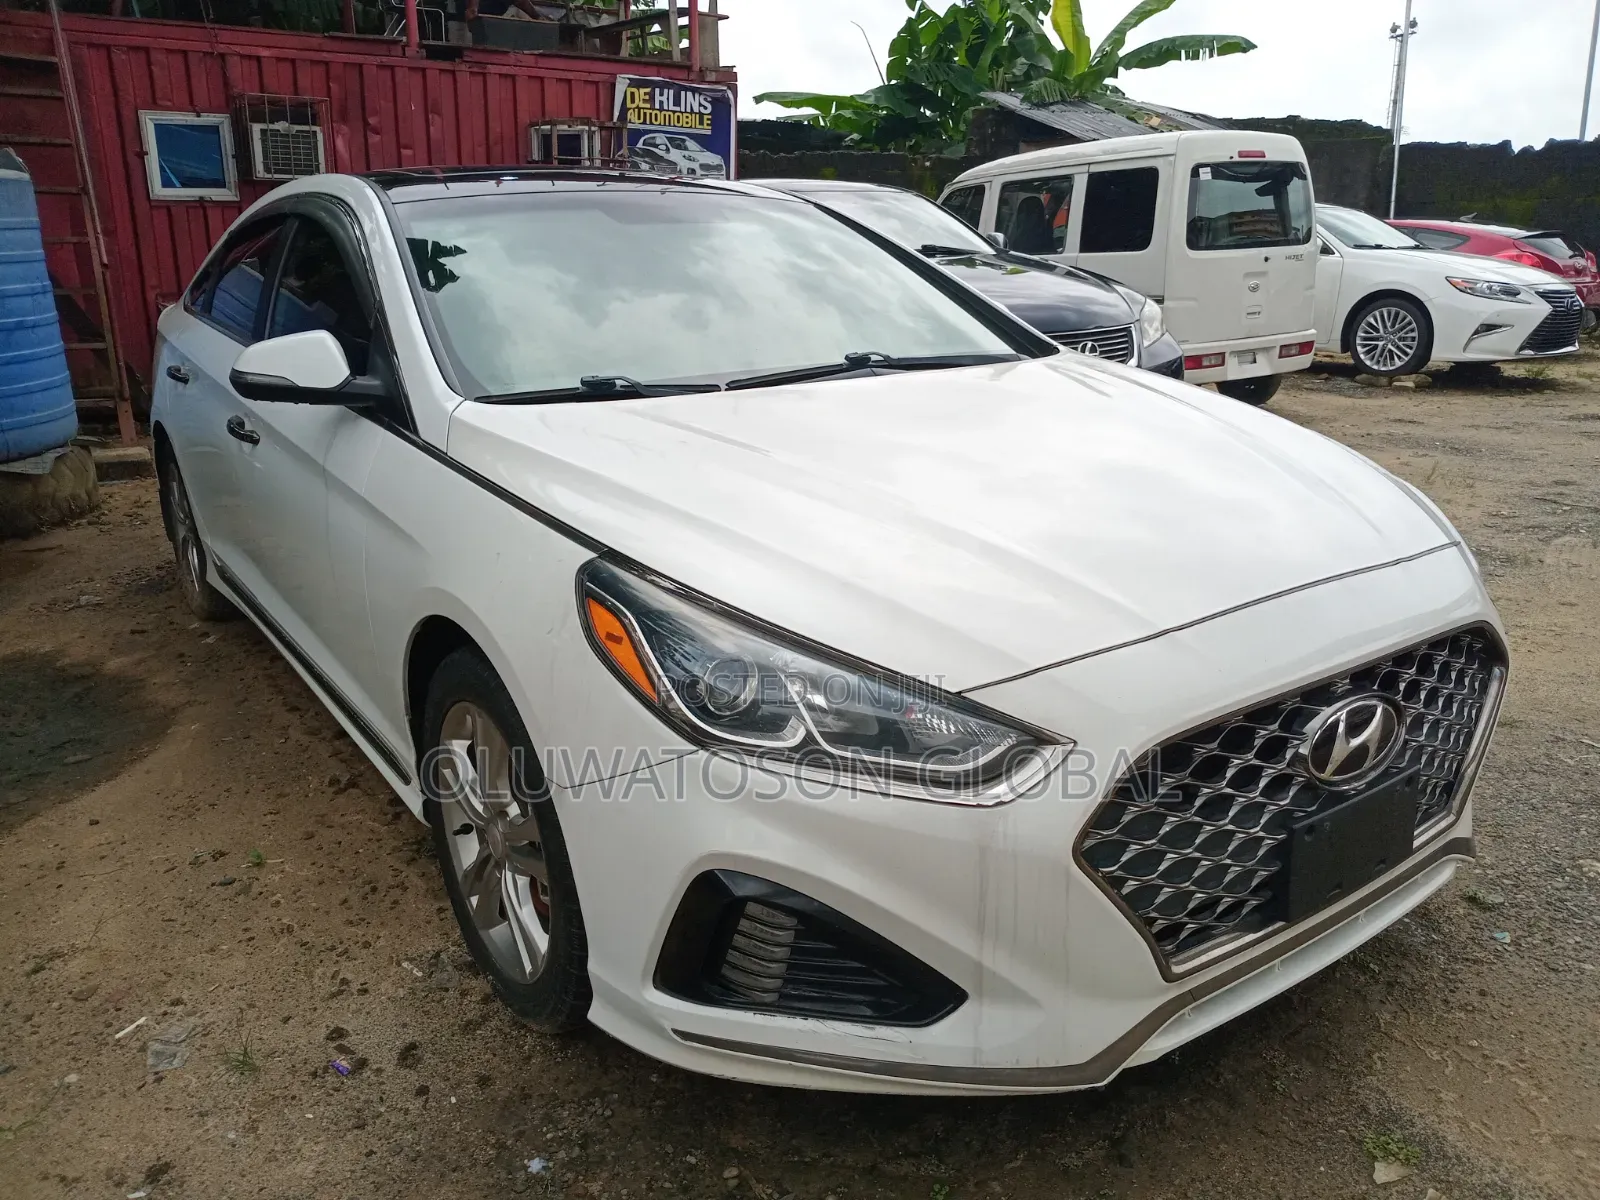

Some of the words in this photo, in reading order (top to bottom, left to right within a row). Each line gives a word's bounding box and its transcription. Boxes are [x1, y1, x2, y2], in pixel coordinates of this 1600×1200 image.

[626, 87, 651, 109] DE
[654, 88, 712, 114] KLINS
[627, 109, 712, 129] AUTOMOBILE
